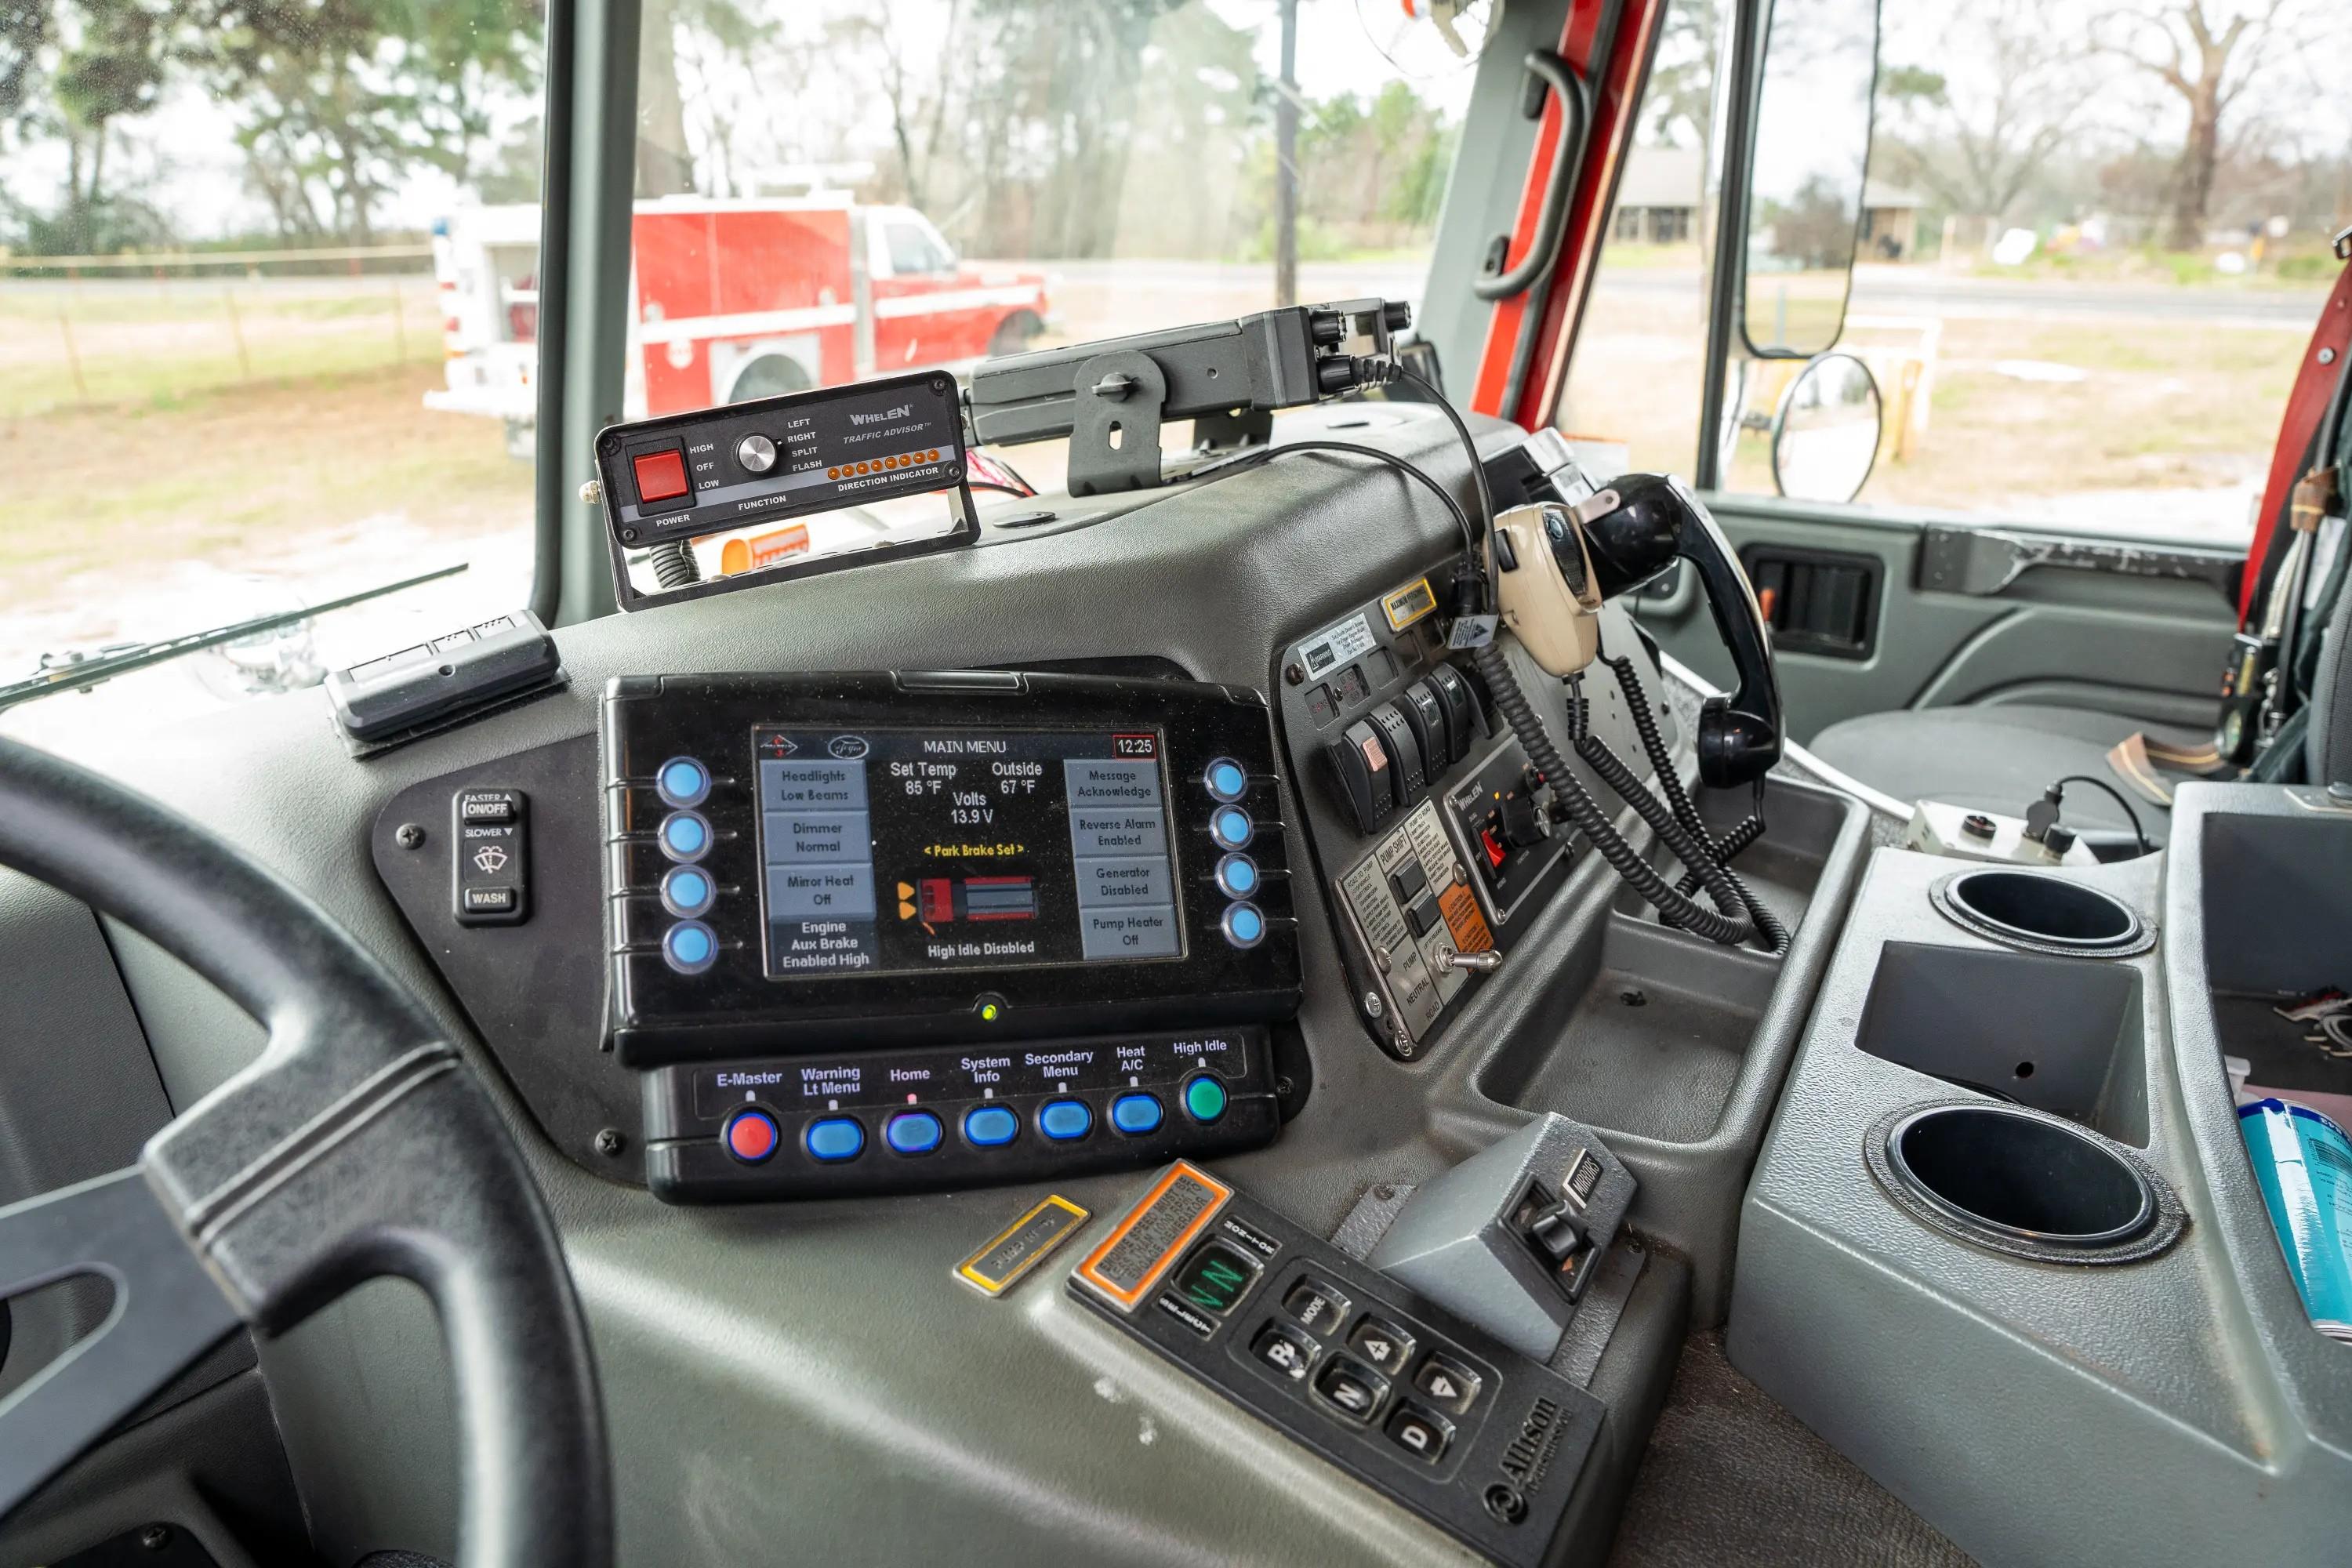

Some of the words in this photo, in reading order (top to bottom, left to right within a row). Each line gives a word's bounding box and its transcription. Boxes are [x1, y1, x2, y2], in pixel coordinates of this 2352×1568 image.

[787, 418, 811, 428] LEFT
[787, 431, 816, 444] RIGHT
[843, 432, 881, 445] TRAFFIC
[689, 443, 714, 455] HIGH
[791, 446, 818, 458] SPLIT
[695, 461, 715, 472] OFF
[792, 459, 823, 472] FLASH
[698, 479, 720, 490] LOW
[837, 476, 887, 492] DIRECTION
[888, 466, 939, 484] INDICATOR
[738, 495, 787, 511] FUNCTION
[655, 514, 691, 528] POWER
[924, 741, 963, 753] MAIN
[967, 741, 1007, 753] MENU
[1117, 739, 1153, 753] 12:25
[891, 763, 916, 776] Set
[917, 764, 956, 779] Temp
[992, 762, 1042, 776] Outside
[1089, 770, 1137, 782] Message
[782, 770, 846, 784] Headlights
[906, 782, 923, 795] 85
[1000, 781, 1016, 793] 67
[1077, 786, 1152, 798] Acknowledge
[781, 789, 804, 801] Low
[808, 789, 849, 801] Beams
[953, 792, 986, 806] Volts
[1458, 781, 1483, 811] WHELEN
[467, 804, 507, 815] ON/OFF
[951, 809, 981, 823] 13.9
[983, 809, 993, 822] V
[793, 823, 843, 835] Dimmer
[1080, 819, 1121, 830] Reverse
[1123, 818, 1156, 829] Alarm
[465, 829, 502, 837] SLOWER
[796, 840, 840, 853] Normal
[1098, 835, 1142, 846] Enabled
[935, 844, 960, 857] Park
[962, 844, 993, 857] Brake
[996, 844, 1015, 856] Set
[1380, 844, 1395, 866] PUMP
[1393, 834, 1407, 853] SHIFT
[1096, 868, 1150, 879] Generator
[1347, 875, 1358, 888] ROAD
[1363, 860, 1374, 873] PUMP
[787, 877, 822, 888] Mirror
[825, 874, 854, 886] Heat
[1101, 884, 1149, 895] Disabled
[472, 893, 506, 904] WASH
[813, 894, 831, 906] Off
[801, 921, 847, 935] Engine
[1093, 919, 1126, 931] Pump
[1128, 917, 1163, 928] Heater
[791, 938, 817, 950] Aux
[819, 936, 858, 949] Brake
[1122, 935, 1139, 946] Off
[928, 945, 956, 960] High
[958, 943, 982, 956] Idle
[984, 941, 1035, 955] Disabled
[782, 955, 837, 968] Enabled
[839, 953, 869, 968] High
[1403, 952, 1417, 971] PUMP
[1406, 978, 1429, 1004] NEUTRAL
[1426, 1002, 1440, 1020] ROAD
[1116, 1046, 1145, 1058] Heat
[1174, 1042, 1202, 1054] High
[1205, 1040, 1227, 1052] Idle
[961, 1058, 1011, 1072] System
[1025, 1051, 1094, 1065] Secondary
[1121, 1058, 1143, 1071] A/C
[801, 1066, 861, 1081] Warning
[891, 1069, 931, 1082] Home
[974, 1071, 1000, 1083] Info
[1043, 1065, 1078, 1078] Menu
[717, 1072, 782, 1087] E-Master
[804, 1083, 818, 1096] Lt
[822, 1081, 861, 1095] Menu
[1573, 1157, 1599, 1197] MIRRORS
[1127, 1210, 1159, 1241] SPEED
[1152, 1187, 1180, 1214] MUST
[1224, 1220, 1275, 1254] MONITOR
[1201, 1260, 1243, 1292] N
[1159, 1298, 1211, 1333] SELECT
[1300, 1296, 1326, 1325] MODE
[1334, 1382, 1362, 1410] N
[1401, 1425, 1428, 1450] D
